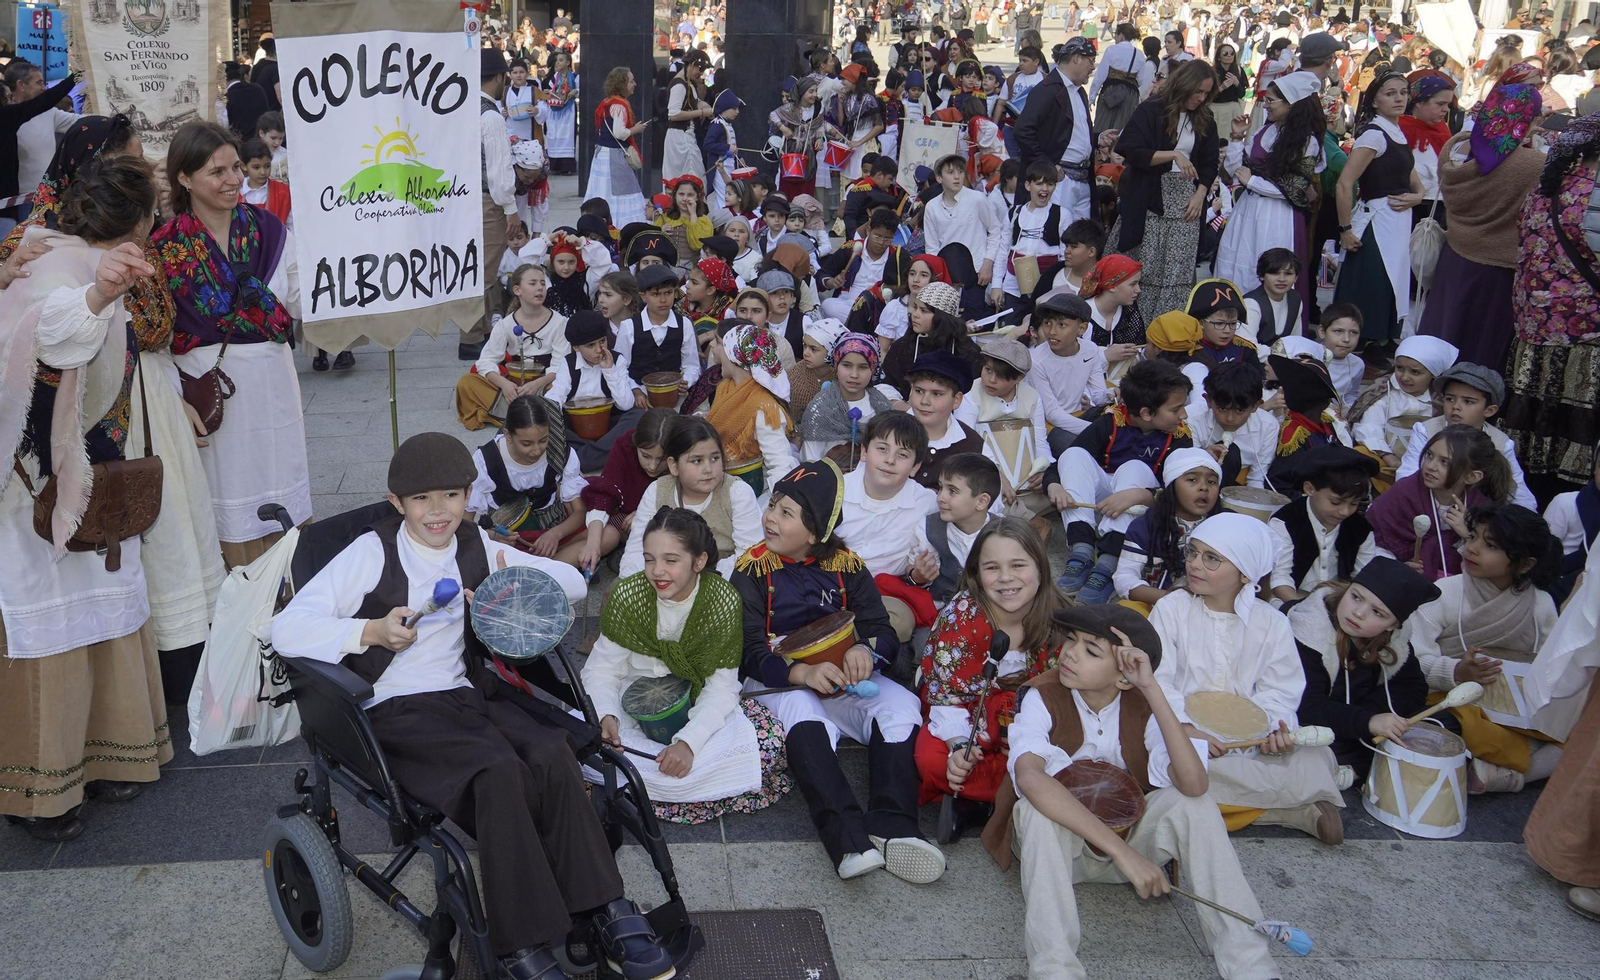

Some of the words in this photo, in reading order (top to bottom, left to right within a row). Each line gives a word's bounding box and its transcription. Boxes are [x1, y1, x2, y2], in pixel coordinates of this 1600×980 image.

[127, 40, 170, 50] COLEXIO
[104, 51, 129, 61] SAN
[131, 50, 189, 61] FERNANDO
[130, 63, 141, 71] DE
[141, 60, 167, 70] VIGO
[139, 80, 165, 92] 1809
[292, 43, 469, 123] COLEXIO
[915, 137, 940, 149] CEIP
[922, 149, 929, 158] A
[320, 181, 396, 212] Colexio
[405, 174, 470, 205] Alborada
[645, 238, 660, 250] N
[311, 238, 478, 314] ALBORADA
[1210, 287, 1233, 307] N
[1138, 446, 1160, 458] N
[781, 468, 818, 483] N
[819, 588, 836, 606] N
